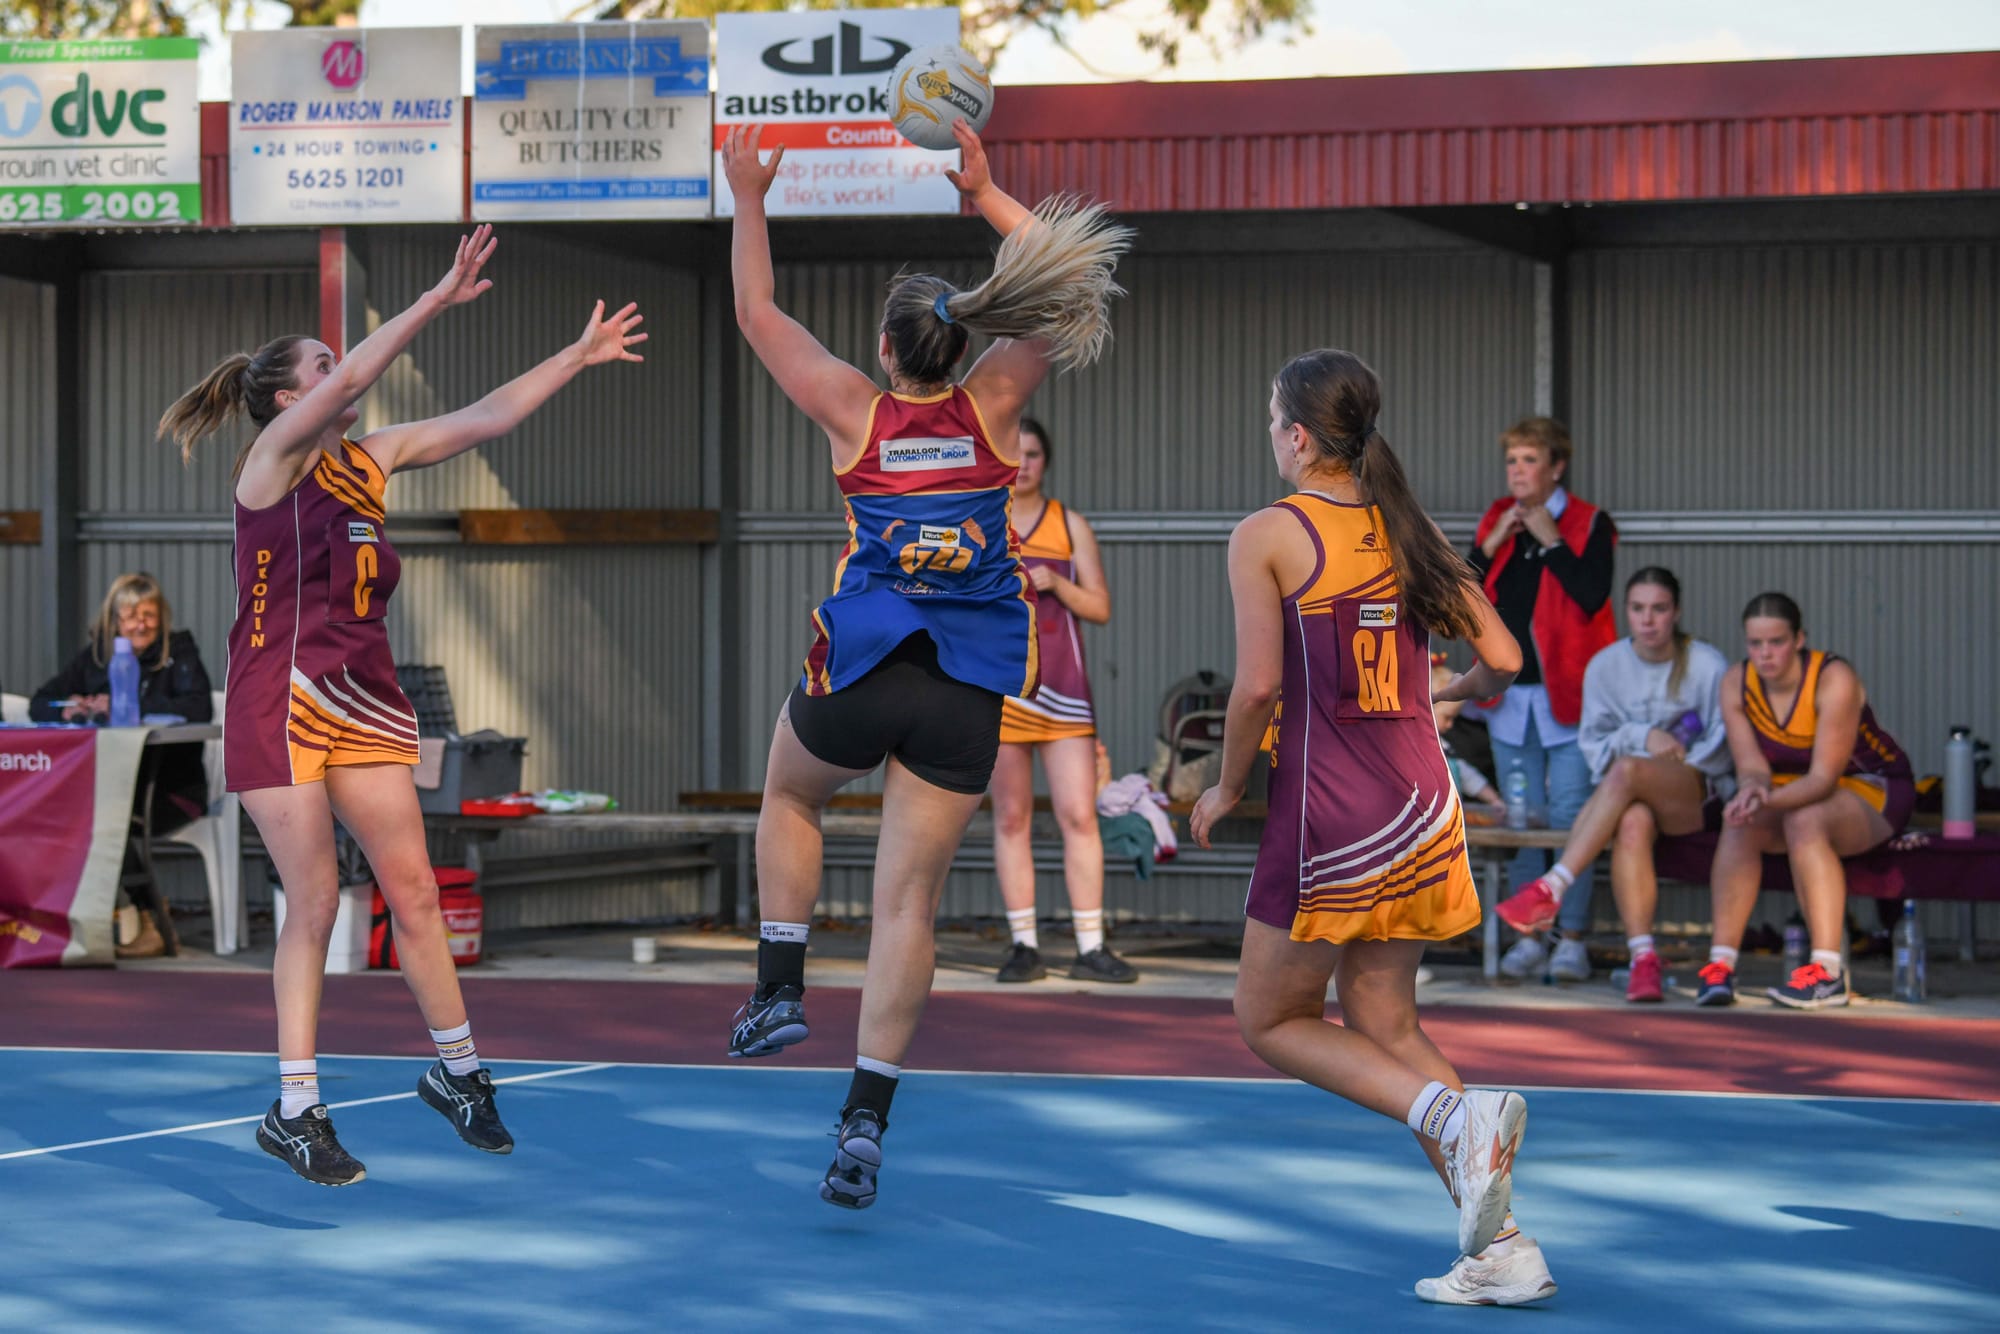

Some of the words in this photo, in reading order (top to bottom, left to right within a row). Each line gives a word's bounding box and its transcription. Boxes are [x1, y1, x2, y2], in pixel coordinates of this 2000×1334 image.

[51, 72, 166, 137] dvc
[240, 101, 298, 122] ROGER
[306, 100, 383, 121] MANSON
[392, 99, 452, 120] PANELS
[725, 87, 888, 116] austbrok
[500, 108, 618, 136] QUALITY
[623, 106, 681, 130] CUT
[266, 142, 286, 157] 24
[295, 141, 343, 156] HOUR
[354, 139, 425, 155] TOWING
[519, 140, 662, 164] BUTCHERS
[0, 155, 56, 177] rouin
[64, 155, 101, 177] vet
[109, 153, 168, 177] clinic
[287, 169, 347, 188] 5625
[355, 167, 404, 186] 1201
[813, 158, 896, 182] protect
[904, 161, 952, 183] your
[0, 192, 63, 219] 625
[82, 191, 180, 219] 2002
[354, 544, 378, 618] C
[251, 549, 271, 648] DROUIN
[1352, 630, 1402, 713] GA
[1270, 702, 1284, 768] WKS
[0, 751, 51, 771] anch
[1428, 1094, 1453, 1136] DROUIN
